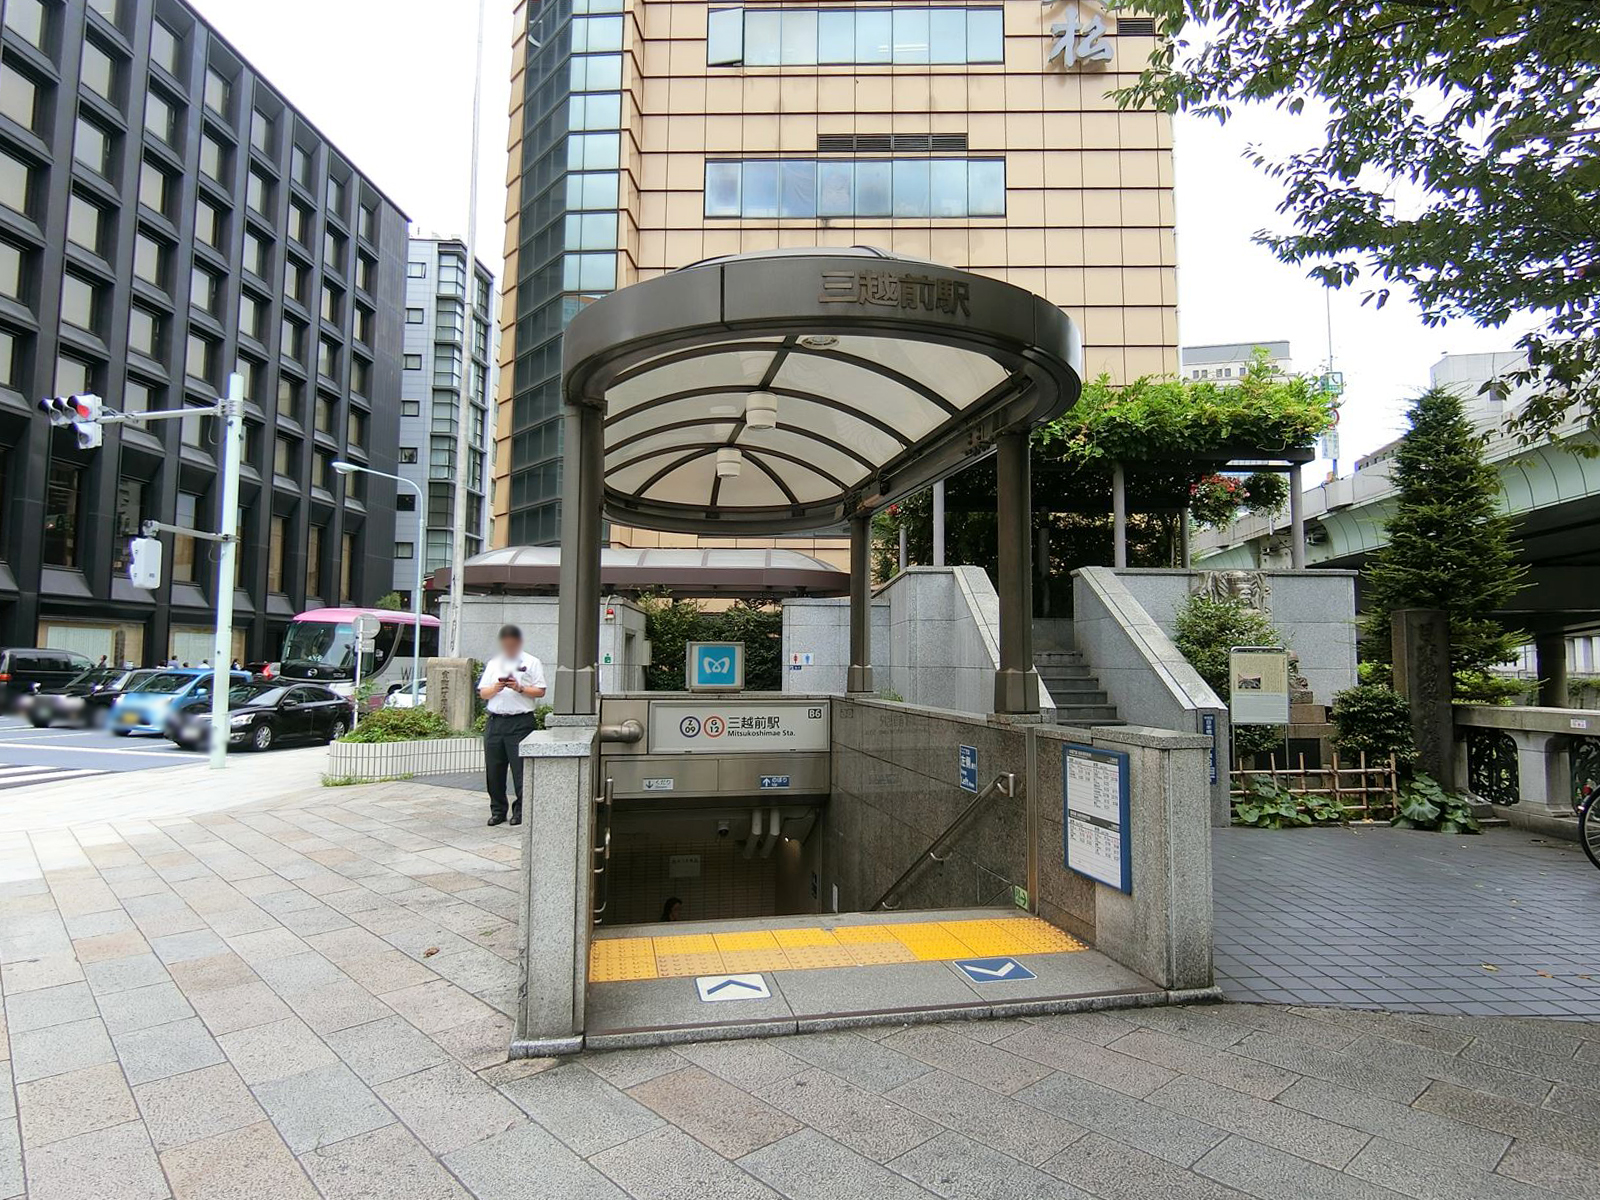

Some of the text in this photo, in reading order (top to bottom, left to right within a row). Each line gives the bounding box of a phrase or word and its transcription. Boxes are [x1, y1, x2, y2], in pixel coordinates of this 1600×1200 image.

[1047, 0, 1115, 69] 松
[818, 269, 971, 317] 三越前駅
[808, 709, 821, 718] B6
[728, 716, 780, 729] 三越前駅
[685, 726, 696, 734] 09
[728, 729, 796, 737] Mitsukoshimae Sta.
